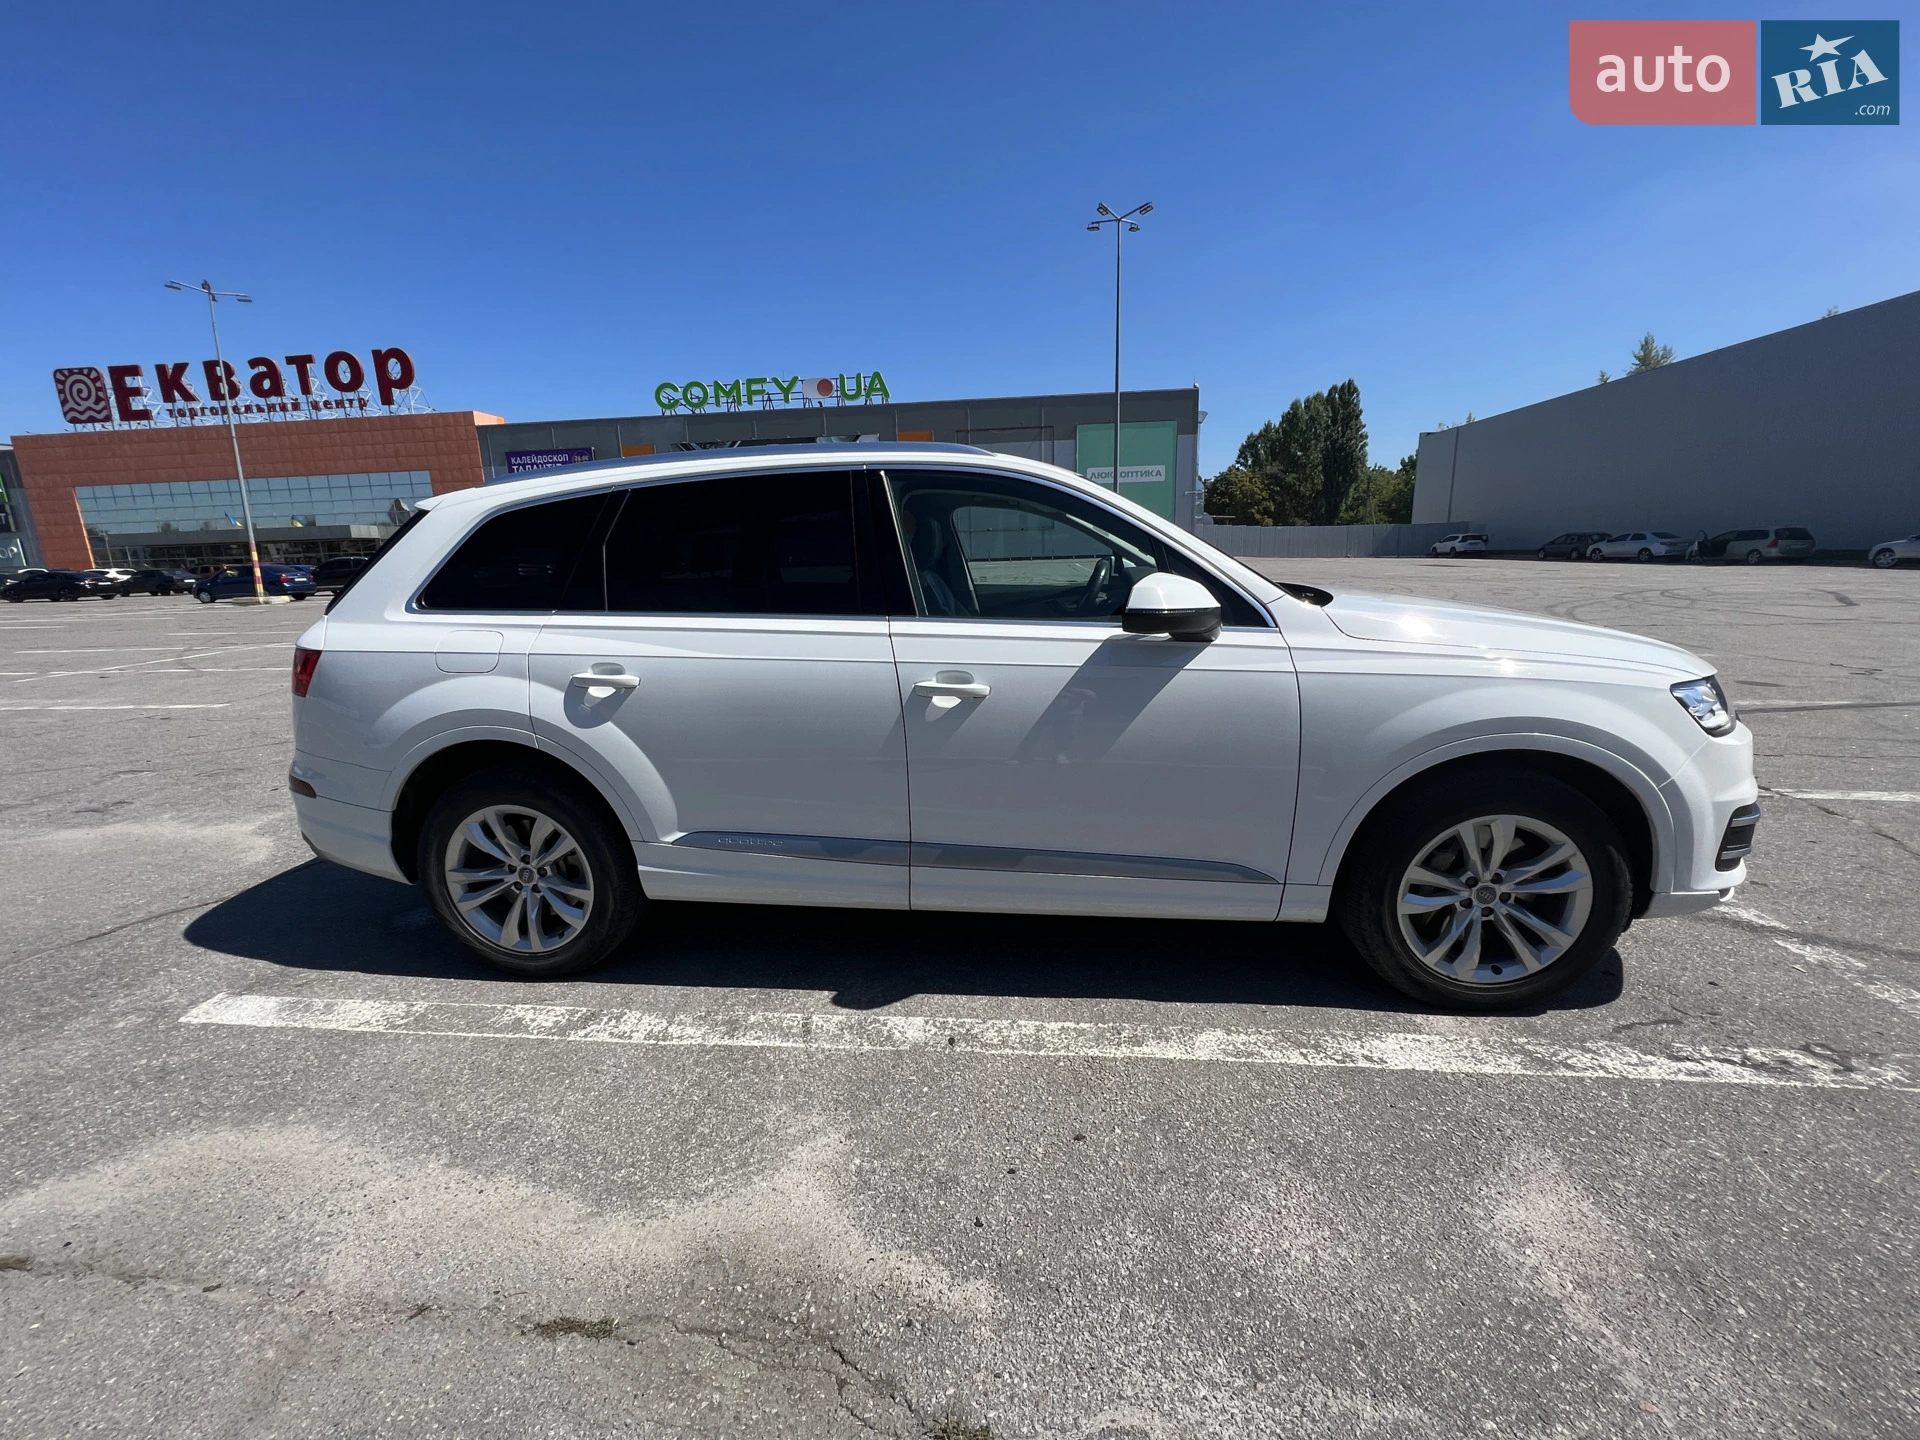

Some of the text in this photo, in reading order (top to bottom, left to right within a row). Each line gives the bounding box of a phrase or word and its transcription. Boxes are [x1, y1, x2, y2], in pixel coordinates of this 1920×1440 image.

[655, 375, 799, 409] COMFY
[166, 397, 369, 419] торговельний центр
[511, 454, 569, 464] КАЛЕЙДОСКОП
